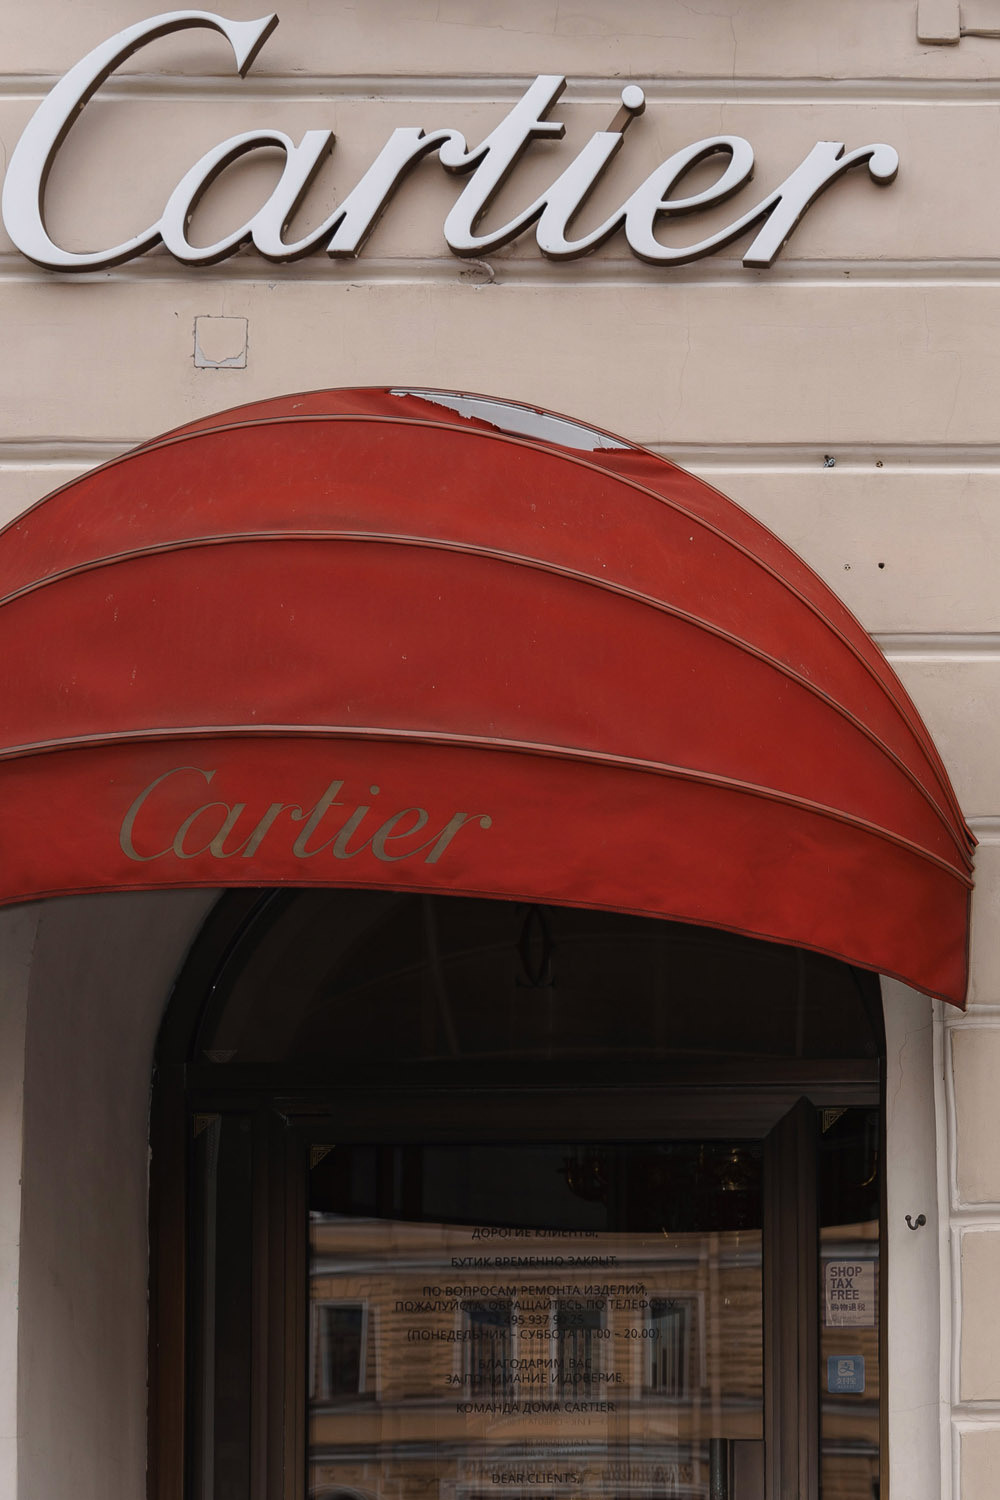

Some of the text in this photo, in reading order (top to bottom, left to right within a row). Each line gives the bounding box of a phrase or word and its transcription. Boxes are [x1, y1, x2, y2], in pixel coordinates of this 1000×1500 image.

[2, 9, 899, 272] Cartier
[119, 766, 493, 864] Cartier
[472, 1228, 531, 1239] ДОРОГИЕ
[451, 1257, 491, 1267] БУТИК
[495, 1256, 564, 1266] ВРЕМЕННО
[830, 1266, 862, 1277] SHOP
[423, 1282, 648, 1297] ПО ВОПРОСАМ РЕМОНТА ИЗДЕЛИЙ,
[830, 1278, 853, 1289] TAX
[830, 1290, 860, 1300] FREE
[489, 1297, 582, 1312] ОБРАЩАЙТЕСЬ
[587, 1300, 605, 1310] ПО
[529, 1315, 549, 1324] 937
[408, 1329, 506, 1341] (ПОНЕДЕЛЬНИК
[520, 1330, 575, 1340] СУББОТА
[579, 1329, 610, 1339] 11.00
[624, 1329, 663, 1341] 20.00).
[479, 1359, 592, 1370] БЛАГОДАРИМ ВАС
[445, 1371, 625, 1385] ЗА ПОНИМАНИЕ И ДОВЕРИЕ.
[456, 1401, 615, 1414] КОМАНДА ДОМА CARTIER
[491, 1472, 580, 1485] DEAR CLIENTS,
